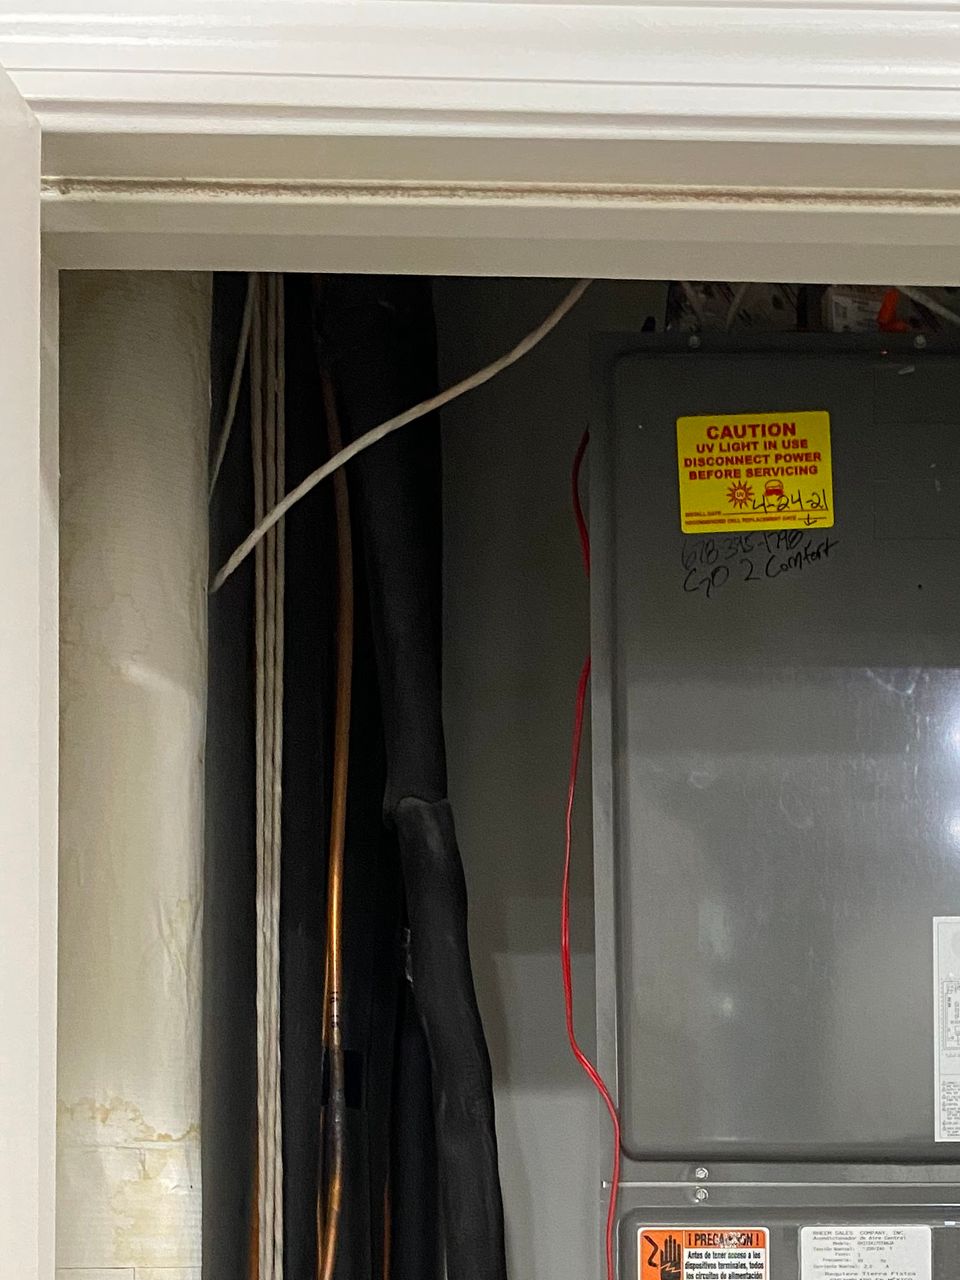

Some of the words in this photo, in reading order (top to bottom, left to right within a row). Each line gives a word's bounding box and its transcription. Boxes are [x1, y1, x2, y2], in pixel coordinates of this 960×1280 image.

[707, 423, 796, 439] CAUTION
[697, 443, 714, 453] UV
[719, 441, 758, 452] LIGHT
[764, 440, 777, 450] IN
[782, 439, 808, 449] USE
[684, 455, 770, 467] DISCONNECT
[775, 452, 821, 463] POWER
[689, 469, 741, 480] BEFORE
[746, 465, 817, 477] SERVICING
[740, 558, 760, 581] 2
[688, 1251, 702, 1259] Antes
[705, 1251, 711, 1259] de
[713, 1251, 726, 1259] tener
